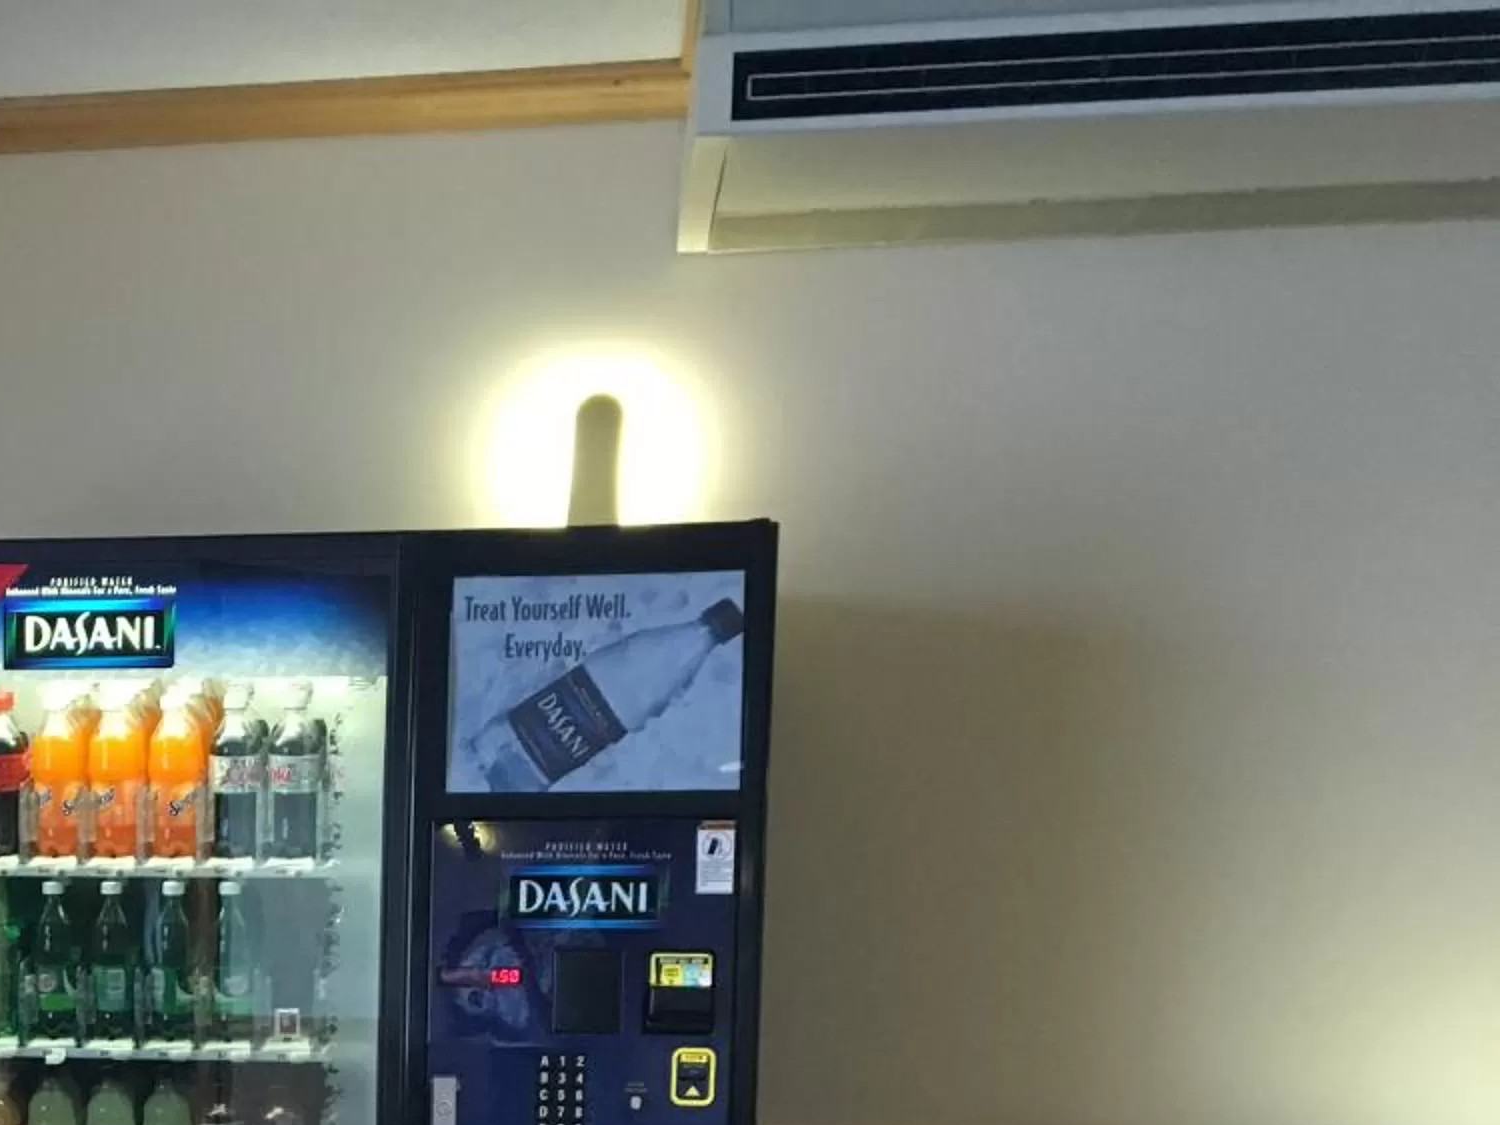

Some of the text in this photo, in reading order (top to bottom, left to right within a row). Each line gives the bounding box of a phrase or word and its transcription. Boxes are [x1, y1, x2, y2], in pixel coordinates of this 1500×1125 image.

[464, 591, 633, 622] Treat Yourself Well.
[24, 611, 156, 656] DASANI
[504, 632, 587, 662] Everyday.
[519, 877, 648, 917] DASANI
[541, 1055, 549, 1067] A
[576, 1055, 584, 1067] 2
